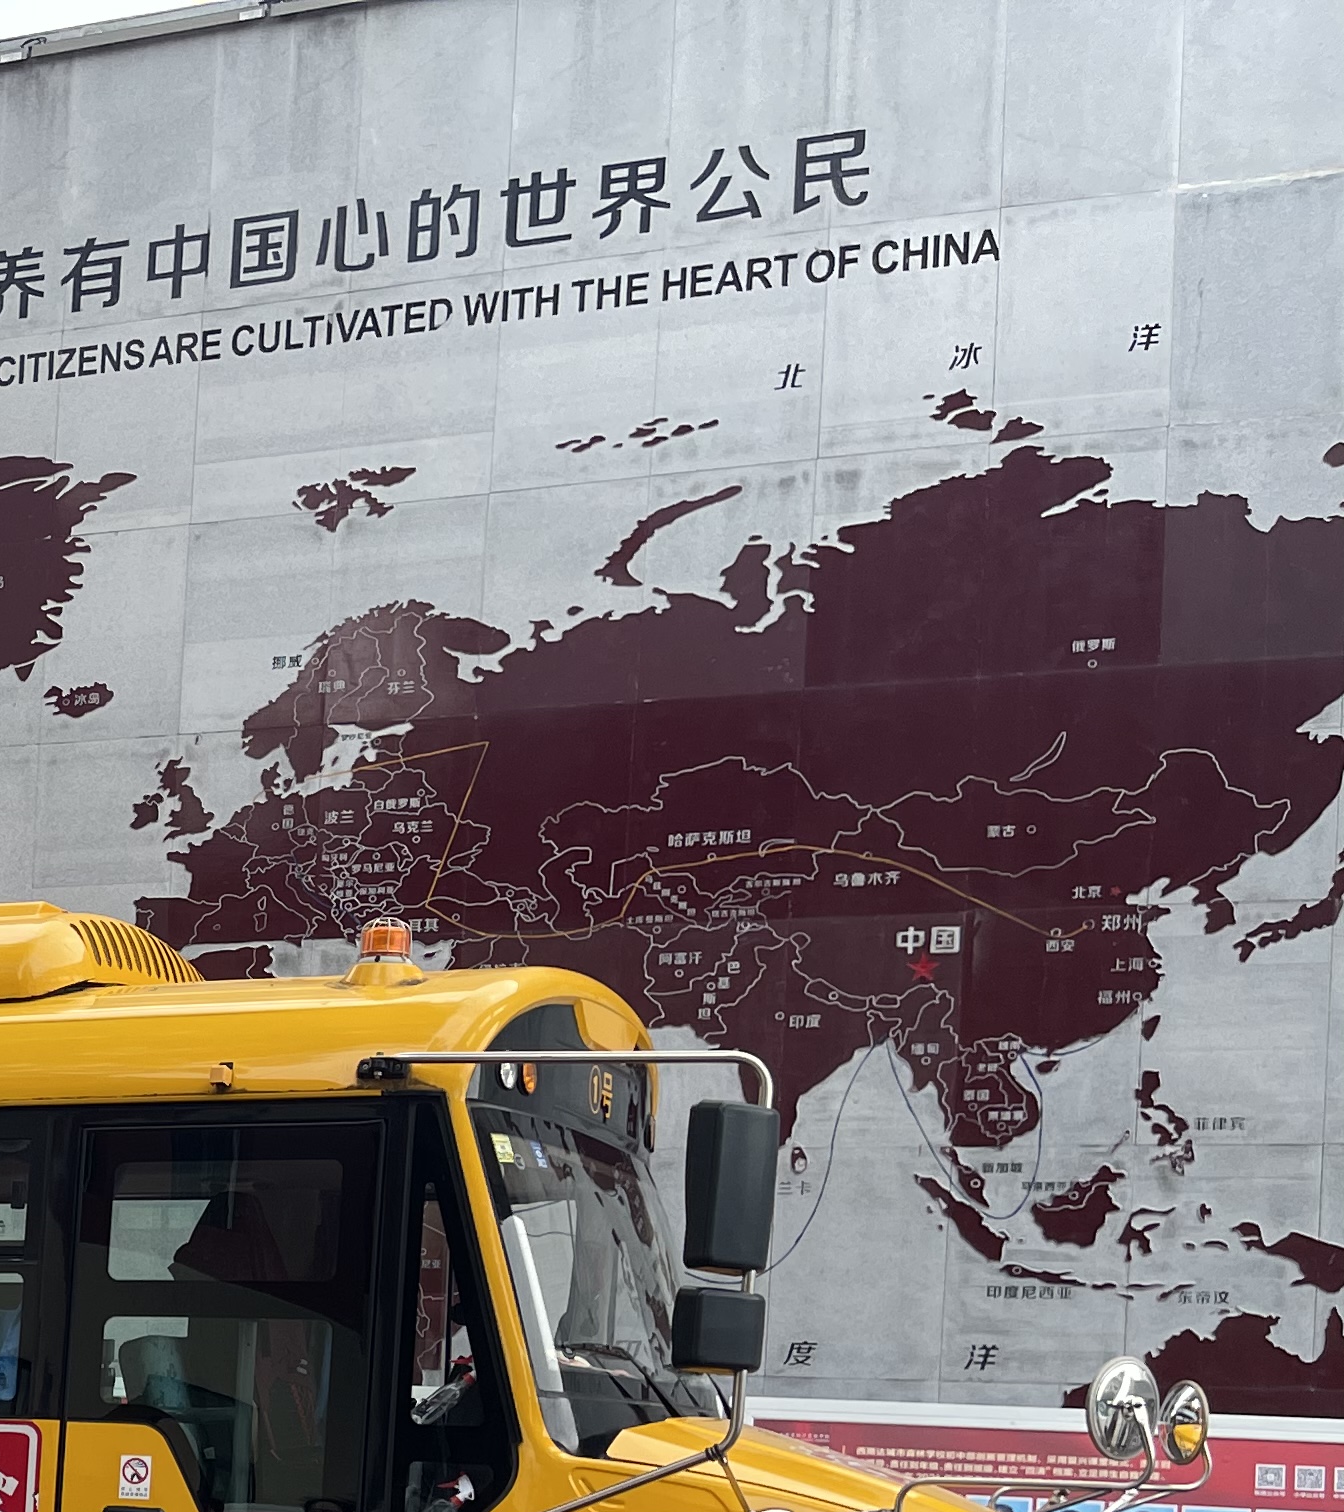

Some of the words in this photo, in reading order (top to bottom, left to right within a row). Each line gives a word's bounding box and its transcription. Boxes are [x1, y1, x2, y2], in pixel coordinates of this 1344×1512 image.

[149, 329, 222, 368] ARE
[231, 298, 453, 358] CULTIVATED
[463, 284, 561, 326] WITH
[569, 273, 650, 313] THE
[661, 252, 799, 303] HEART
[805, 243, 861, 284] OF
[871, 228, 1001, 273] CHINA
[775, 362, 805, 390] 北
[949, 342, 982, 371] 冰
[1129, 322, 1161, 352] 洋
[1071, 636, 1117, 653] 俄罗斯
[272, 655, 303, 670] 挪威
[387, 680, 415, 695] 芬兰
[74, 691, 100, 706] 冰岛
[324, 810, 355, 825] 波兰
[392, 820, 434, 834] 乌克兰
[986, 824, 1016, 838] 蒙古
[667, 829, 752, 848] 哈萨克斯坦
[351, 862, 395, 874] 罗马尼亚
[833, 870, 901, 888] 乌鲁木齐
[1071, 884, 1102, 900] 北京
[1101, 914, 1143, 932] 郑州
[895, 925, 961, 954] 中国
[1045, 939, 1075, 952] 西安
[658, 951, 703, 966] 阿富汗
[1110, 956, 1144, 972] 上海
[1097, 989, 1132, 1005] 福州
[789, 1014, 821, 1030] 印度
[1193, 1115, 1247, 1132] 菲律宾
[986, 1285, 1072, 1300] 印度尼西亚
[1176, 1290, 1230, 1305] 东帝汶
[783, 1340, 818, 1367] 度
[964, 1343, 1000, 1371] 洋
